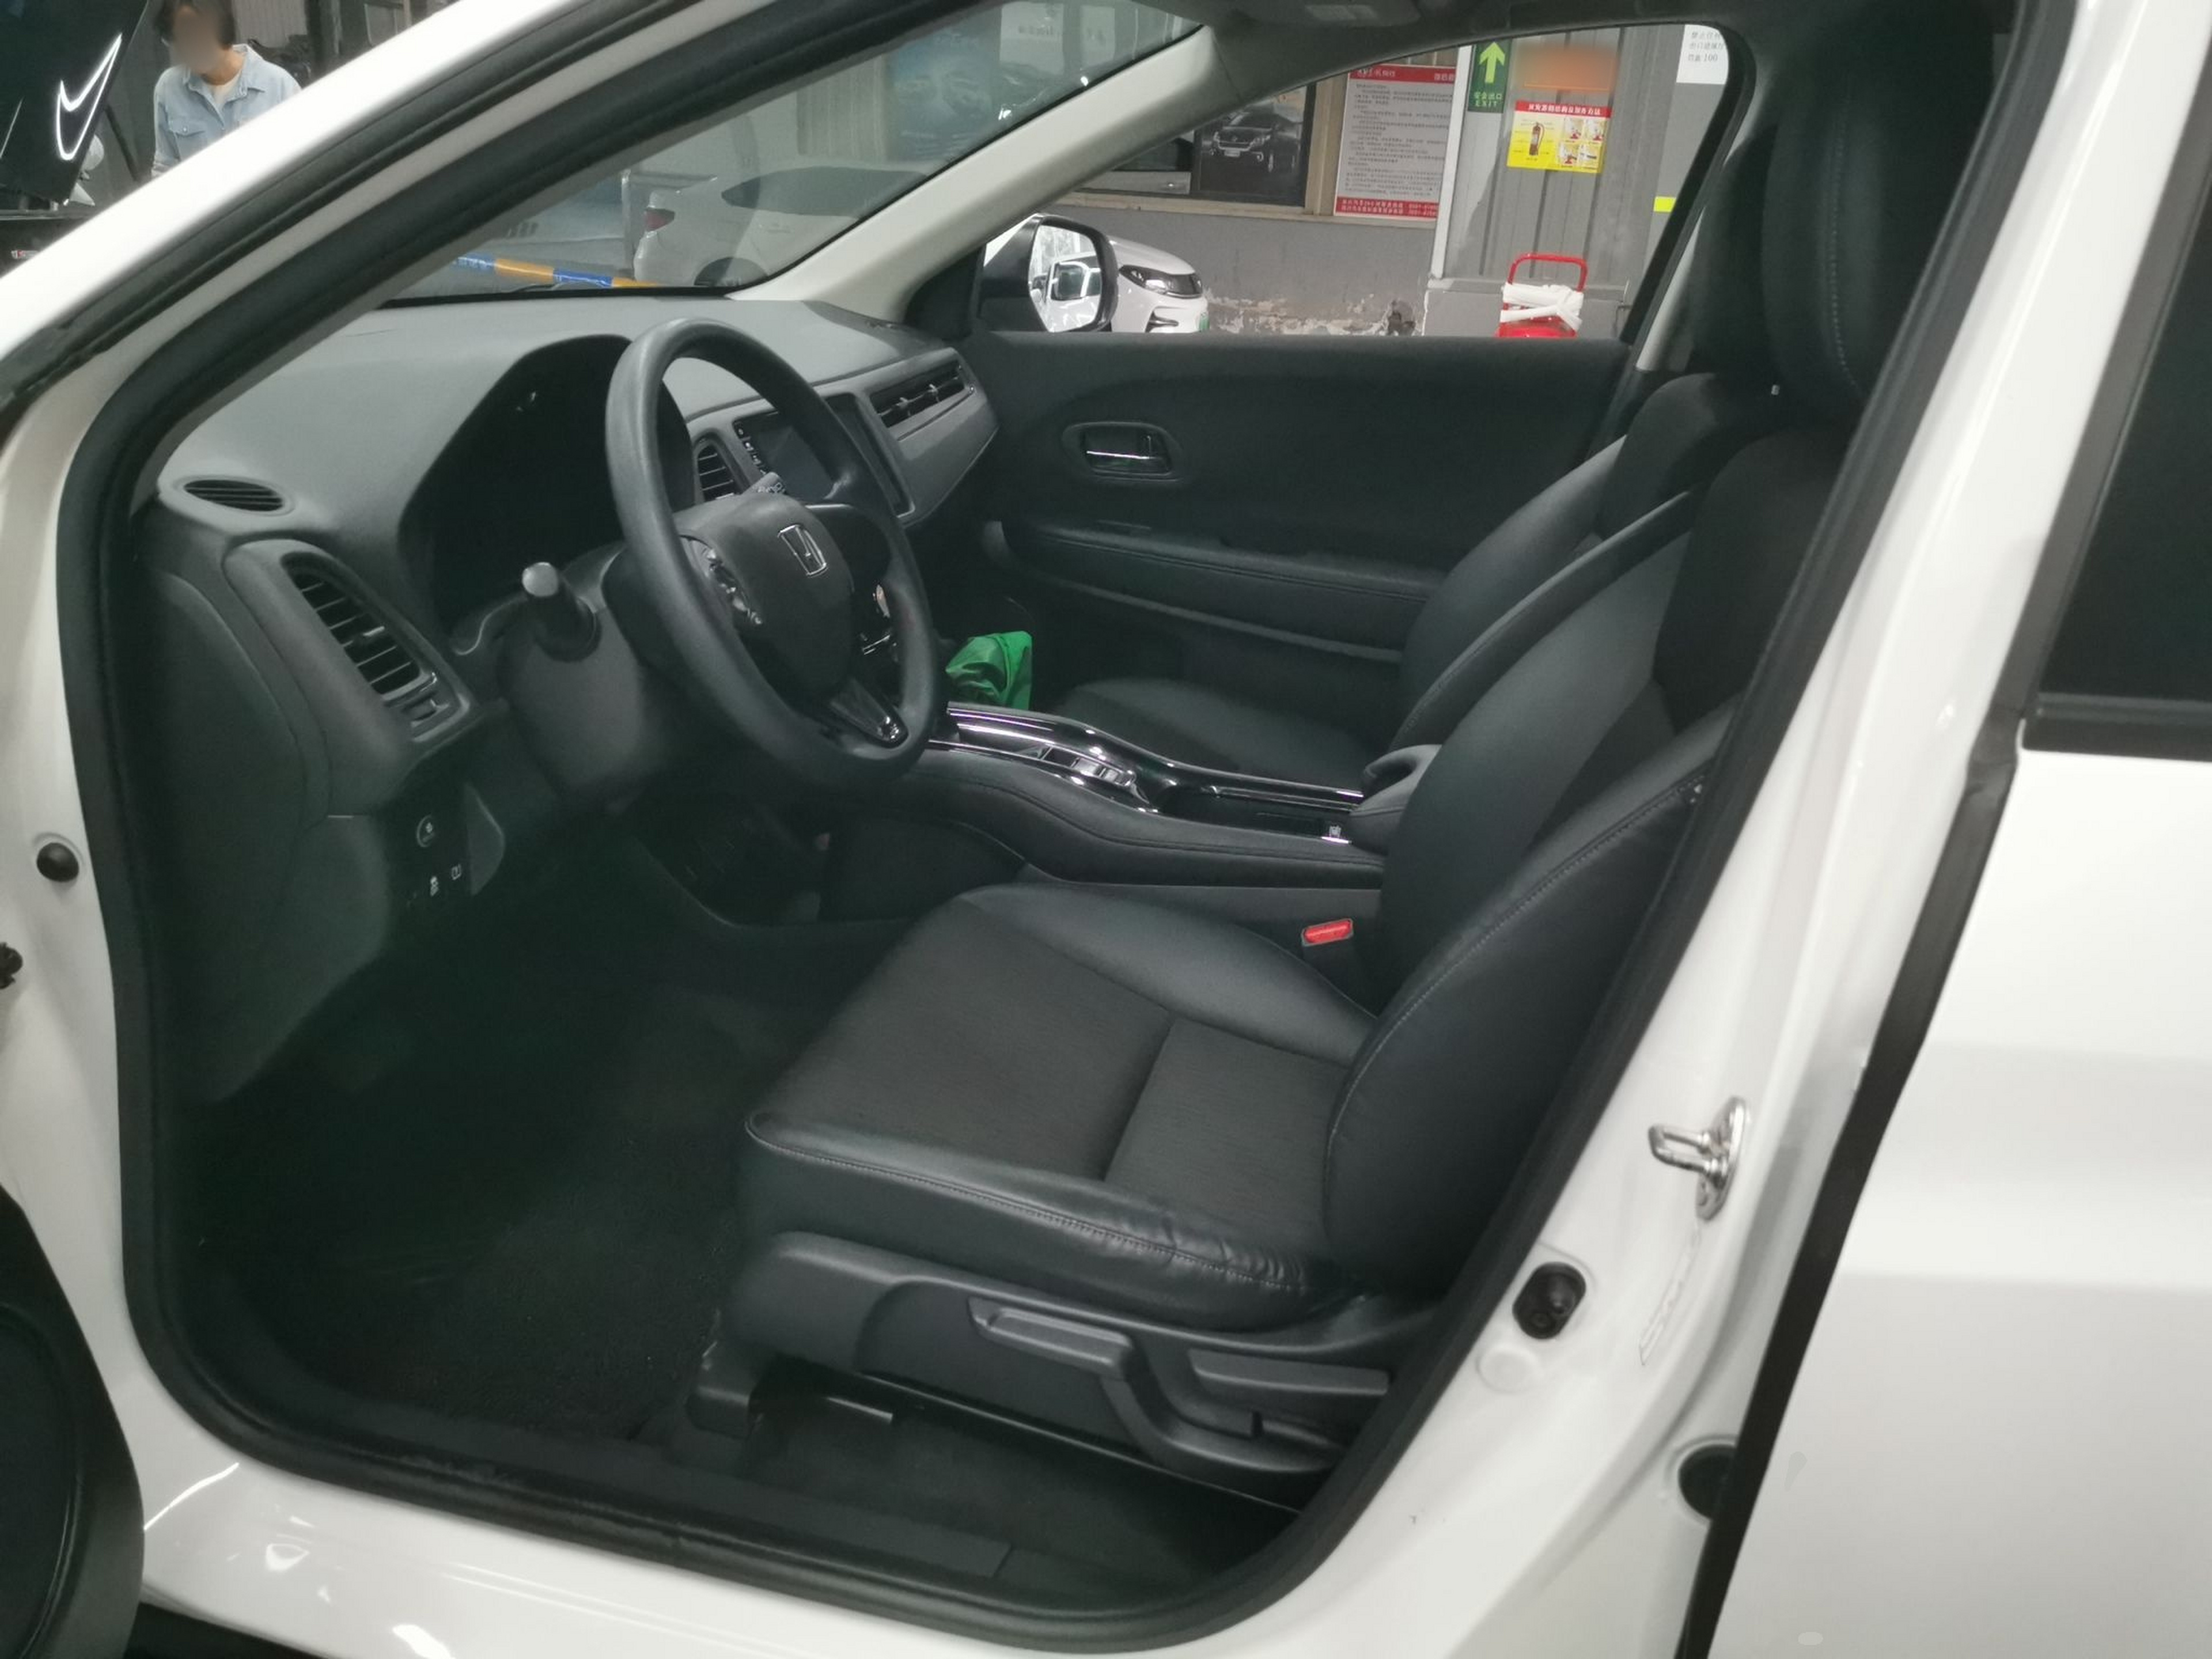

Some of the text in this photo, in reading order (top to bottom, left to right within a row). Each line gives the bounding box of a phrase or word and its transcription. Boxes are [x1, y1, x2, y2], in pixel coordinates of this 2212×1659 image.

[1704, 53, 1718, 62] 100
[1474, 92, 1502, 100] 安全出口
